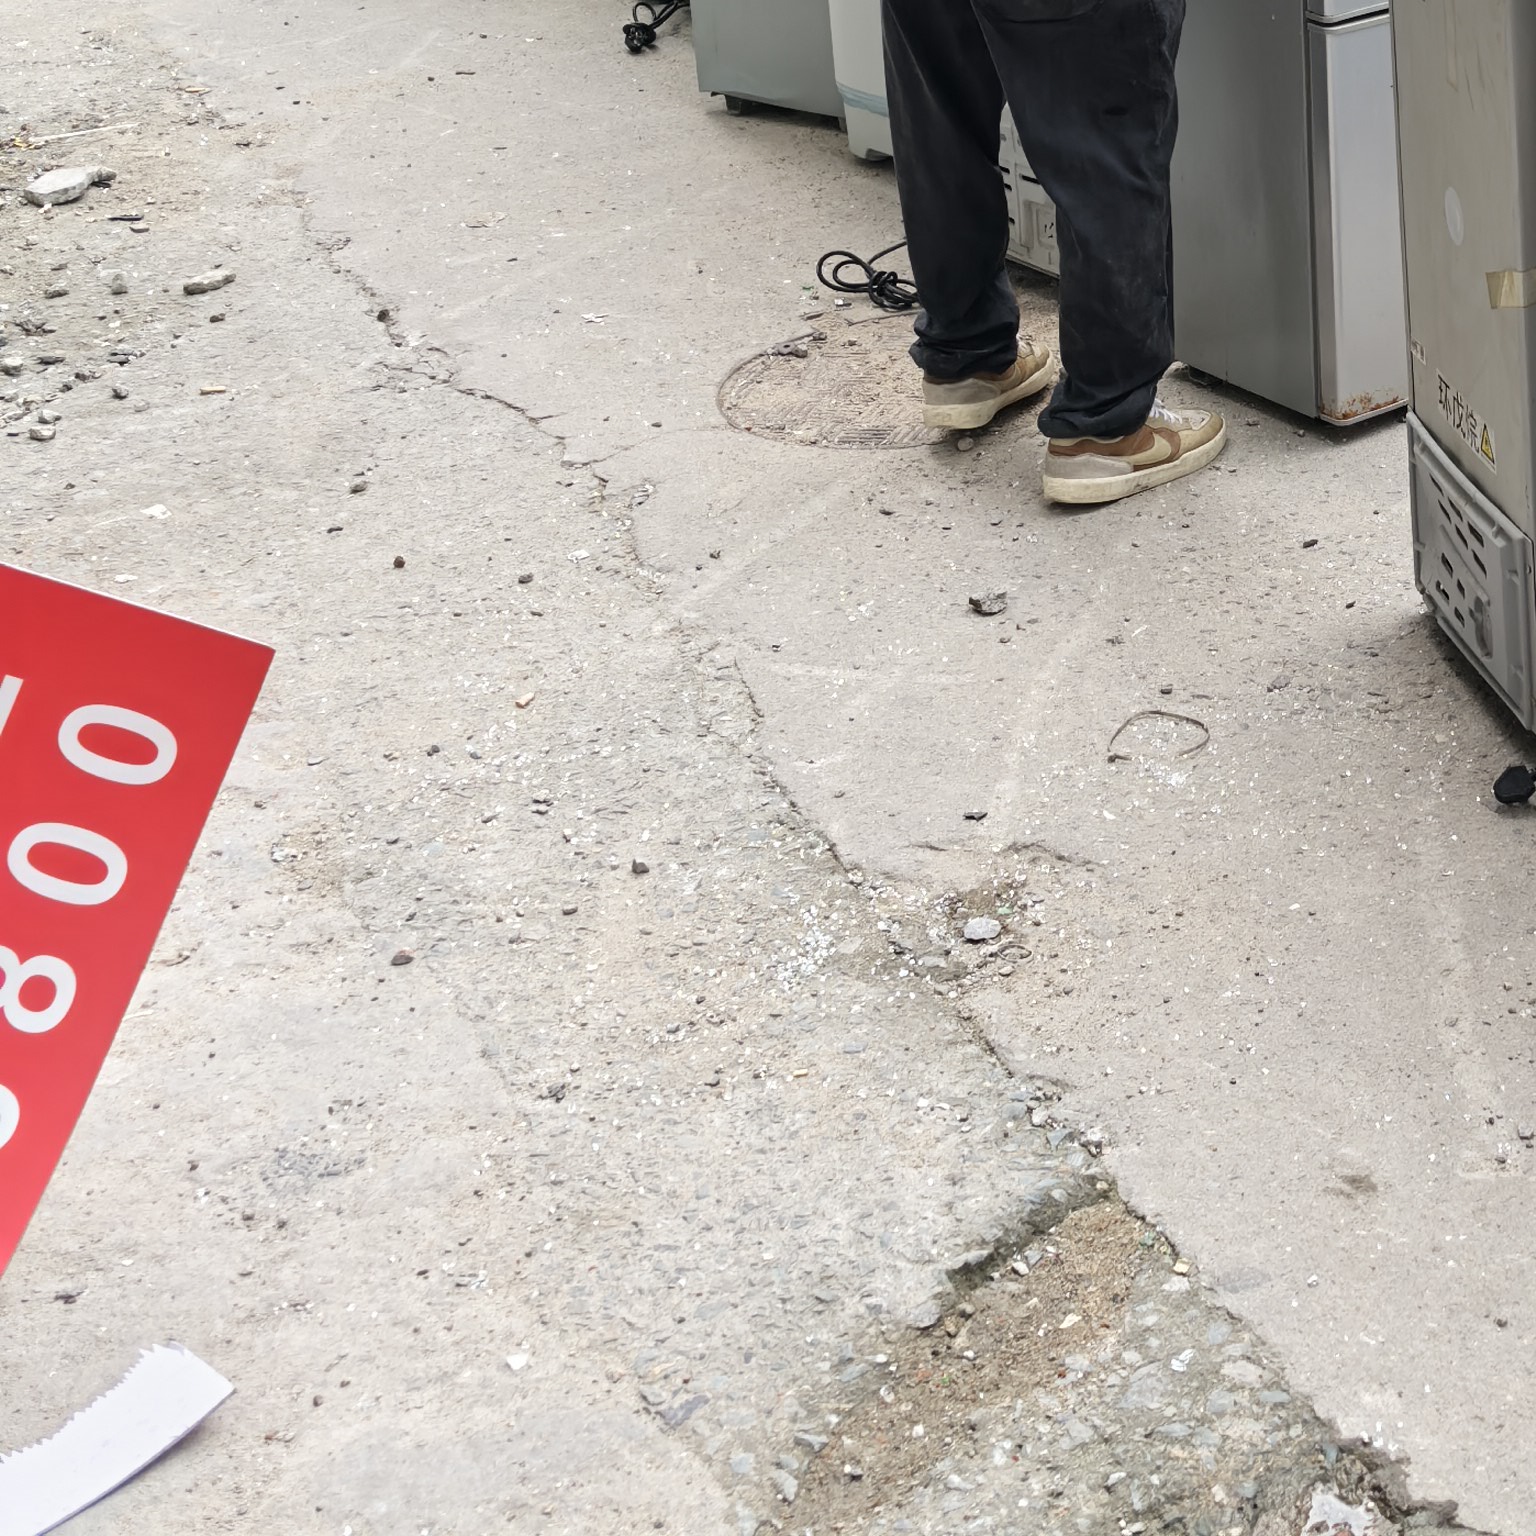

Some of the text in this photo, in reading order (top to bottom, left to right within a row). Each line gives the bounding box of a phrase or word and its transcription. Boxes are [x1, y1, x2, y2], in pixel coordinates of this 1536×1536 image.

[1437, 373, 1480, 454] 环戊烷
[0, 703, 178, 1152] 800
